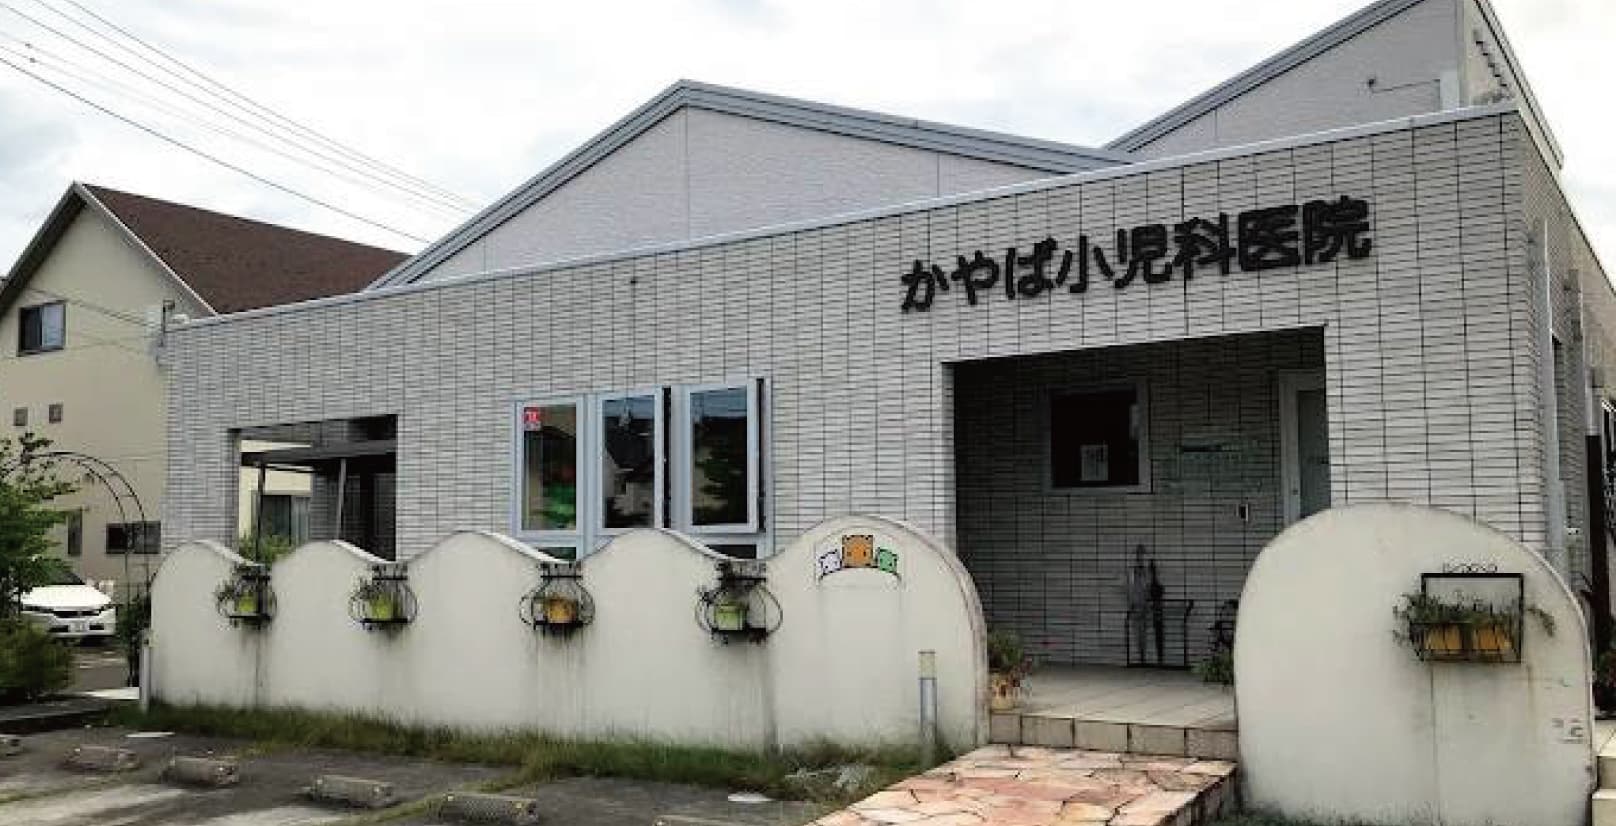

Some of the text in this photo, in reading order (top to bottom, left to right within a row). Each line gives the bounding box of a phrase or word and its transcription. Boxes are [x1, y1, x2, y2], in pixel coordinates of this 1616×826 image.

[901, 195, 1371, 312] かやば小児科医院
